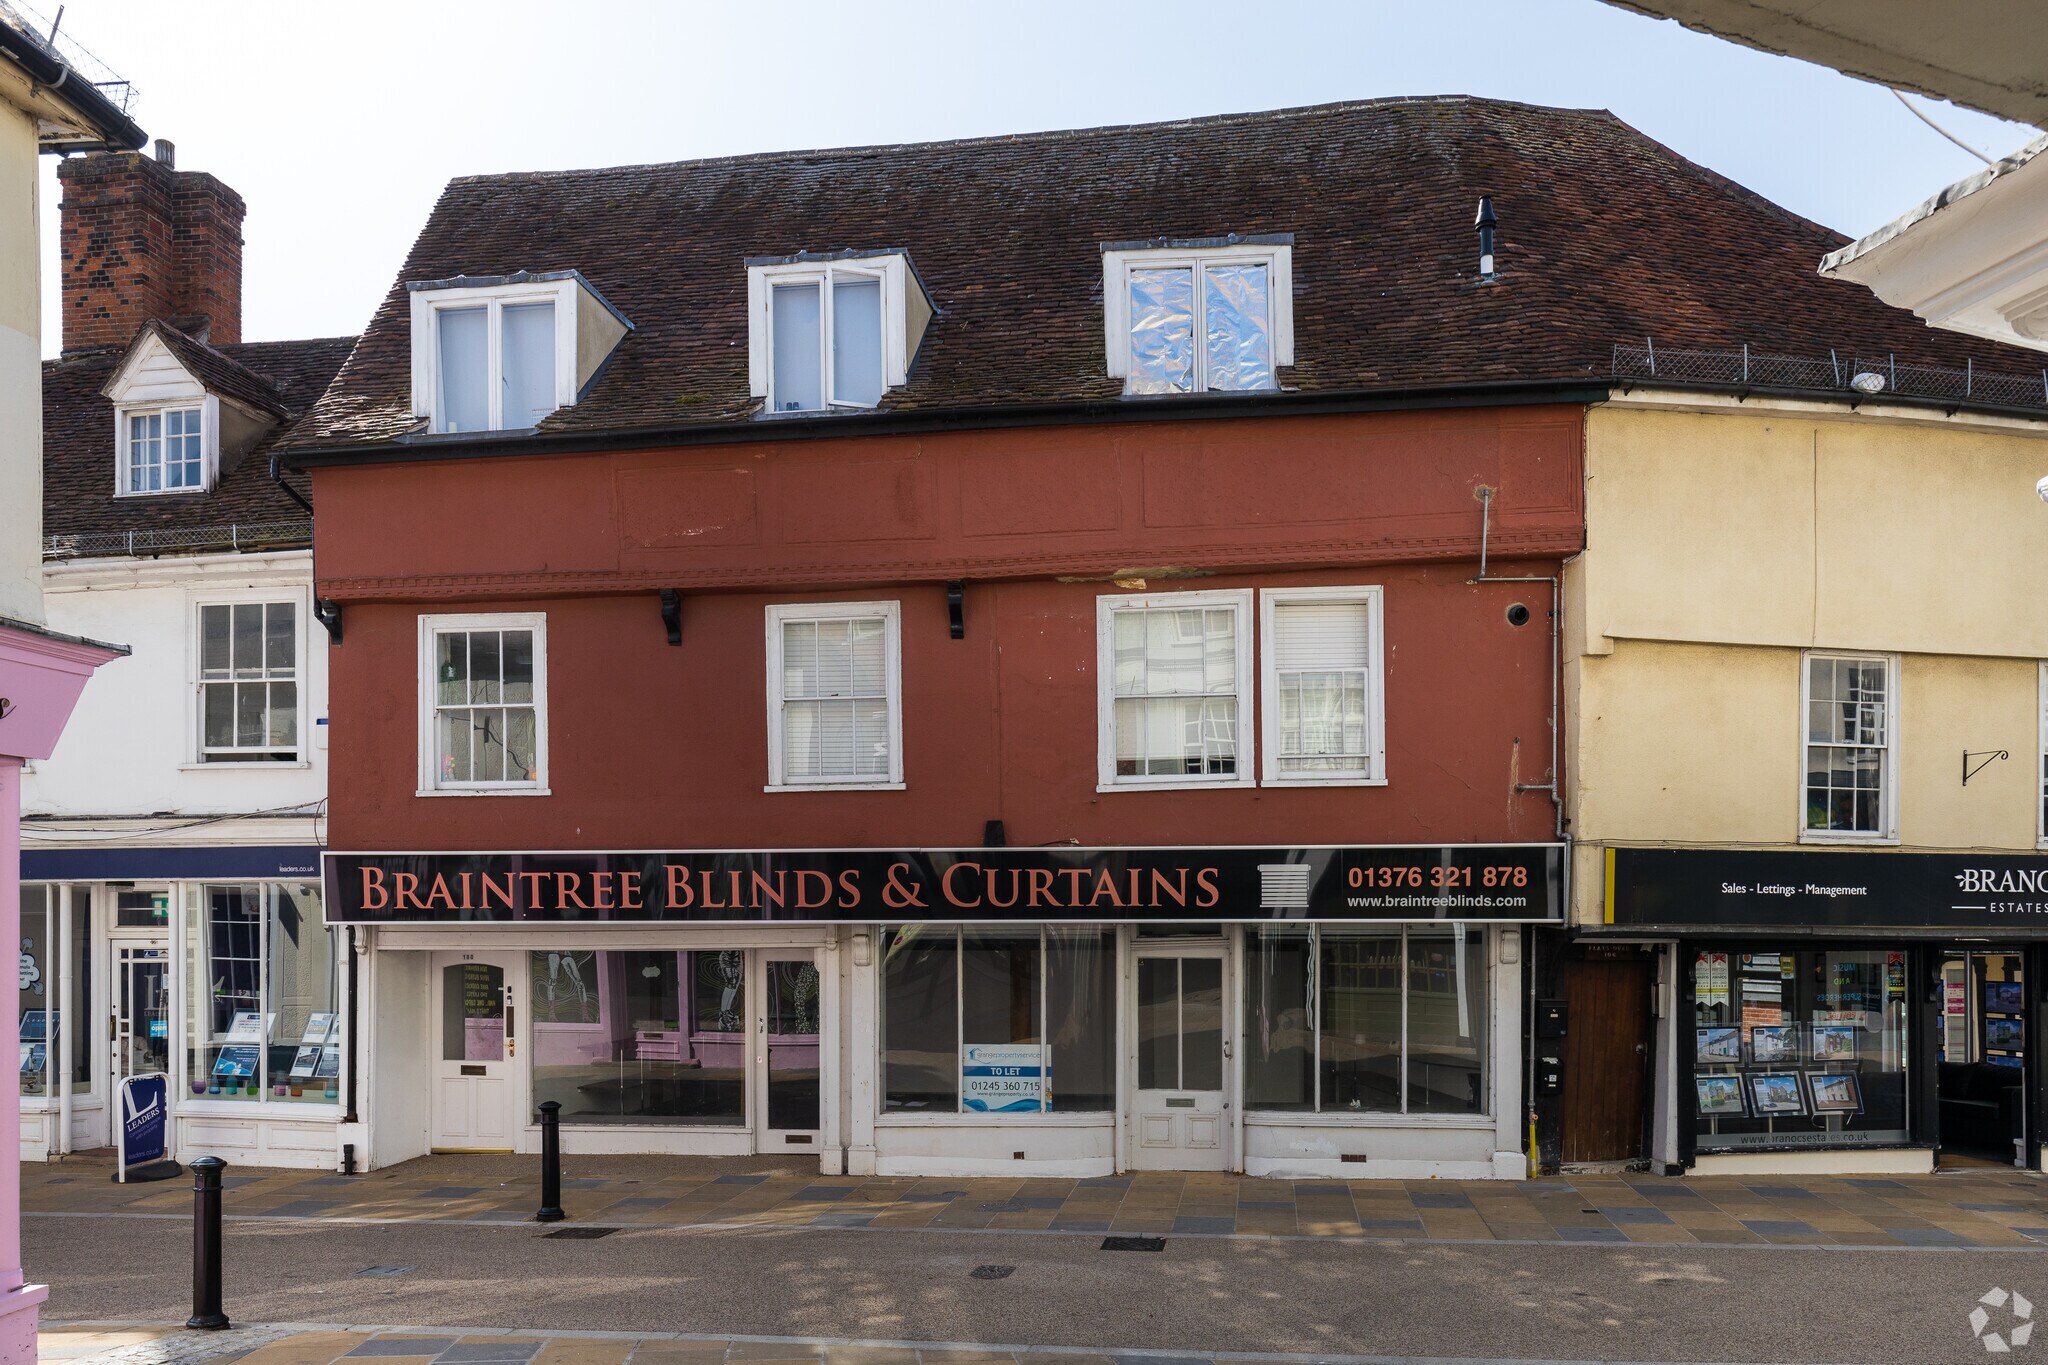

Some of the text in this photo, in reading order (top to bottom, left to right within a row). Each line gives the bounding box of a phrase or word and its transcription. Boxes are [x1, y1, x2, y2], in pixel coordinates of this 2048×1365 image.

[1348, 866, 1528, 888] 01376 321 878
[358, 862, 1220, 909] BRAINTREE BLINDS & CURTAINS
[1721, 882, 1747, 894] Sales
[1756, 882, 1796, 898] Lettings
[1805, 883, 1868, 898] Management
[1347, 895, 1527, 907] www.braintreeblinds.com
[991, 1067, 1021, 1076] TO LET
[971, 1081, 1040, 1091] 01245 360 715
[127, 1107, 160, 1132] LEADERS
